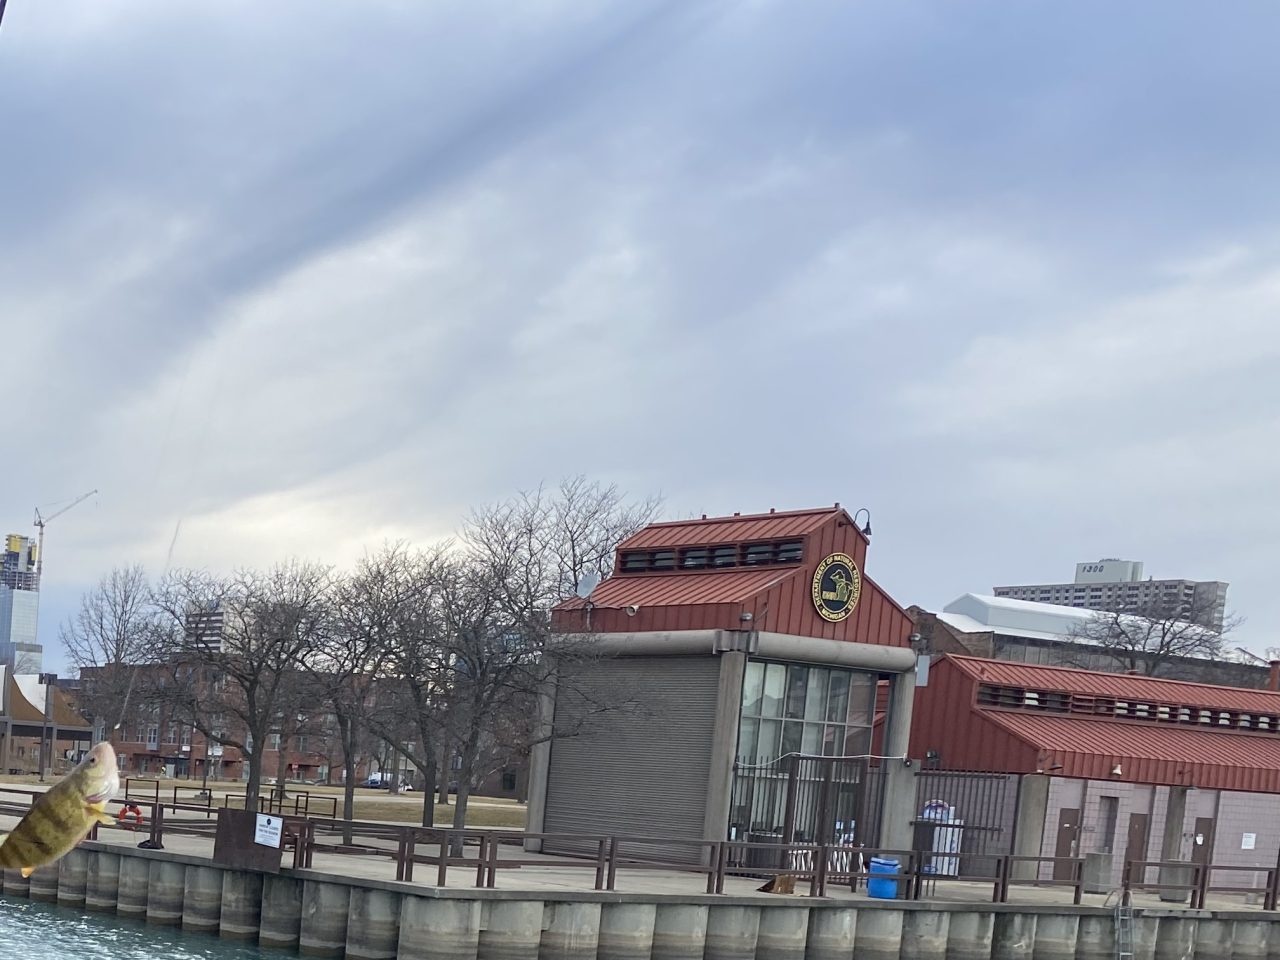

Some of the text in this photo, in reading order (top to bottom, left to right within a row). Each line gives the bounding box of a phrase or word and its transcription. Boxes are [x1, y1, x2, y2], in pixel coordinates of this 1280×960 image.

[1082, 565, 1104, 573] 1300
[814, 564, 827, 605] DEPARTMENT
[834, 555, 854, 570] NATURAL
[848, 570, 859, 610] RESOURCES
[822, 608, 846, 619] MICHIGAN
